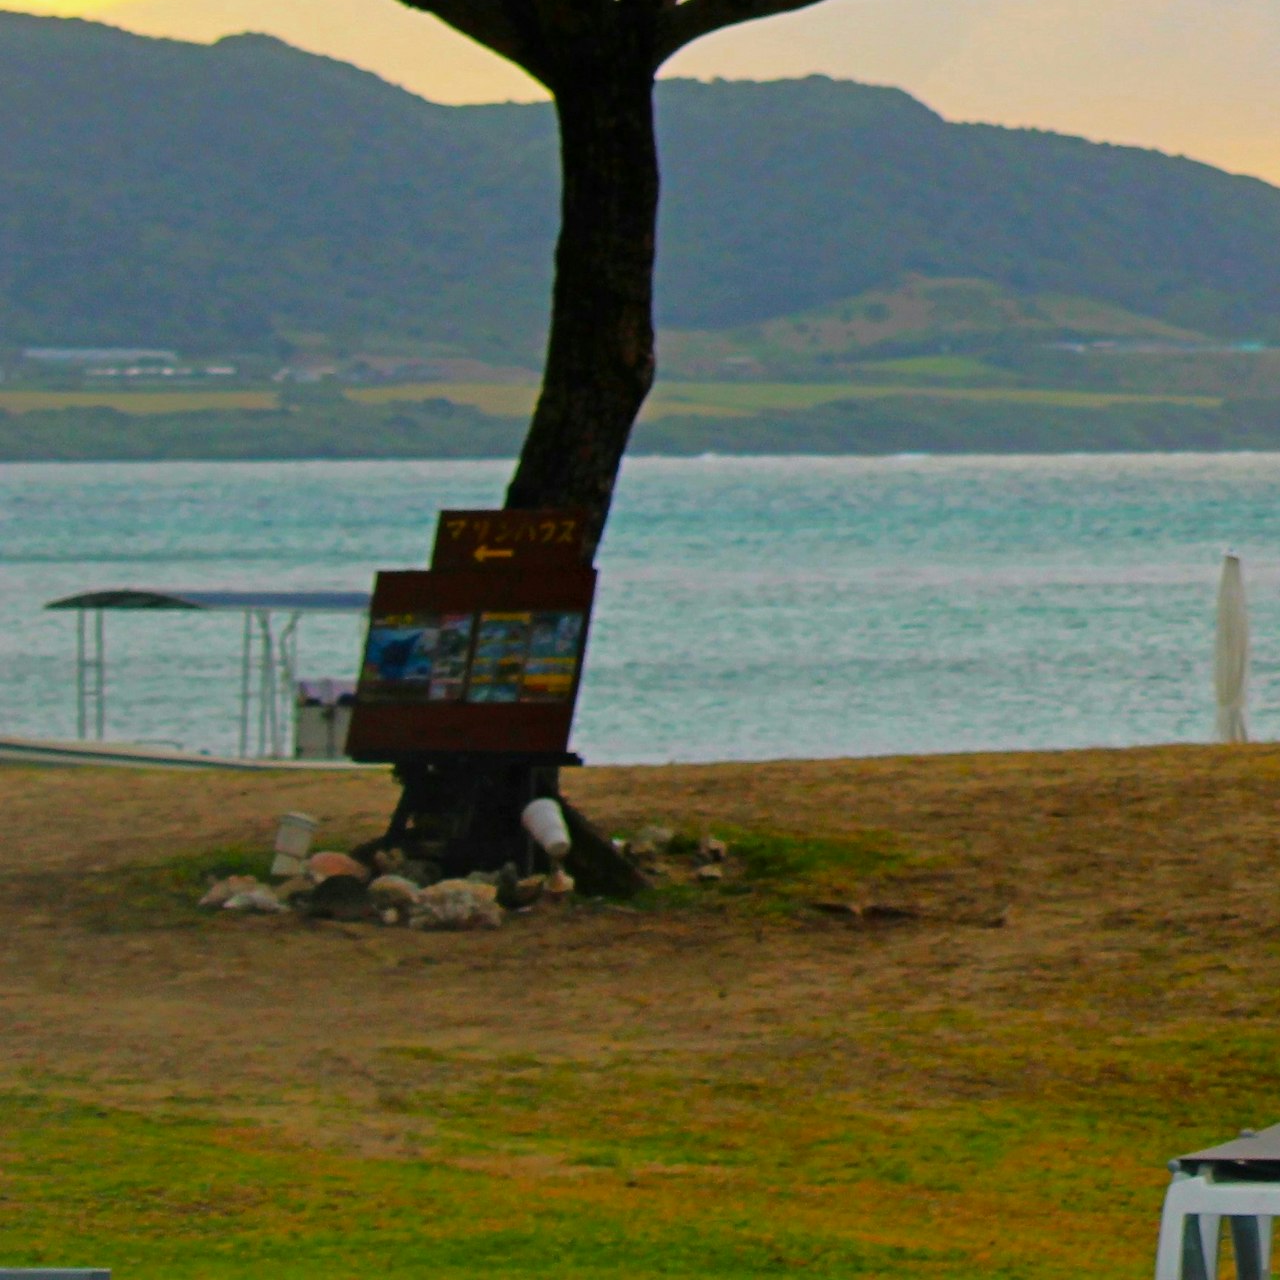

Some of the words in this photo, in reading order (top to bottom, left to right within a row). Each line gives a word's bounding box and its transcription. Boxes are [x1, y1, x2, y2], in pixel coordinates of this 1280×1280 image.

[446, 519, 577, 544] マリンハウス
